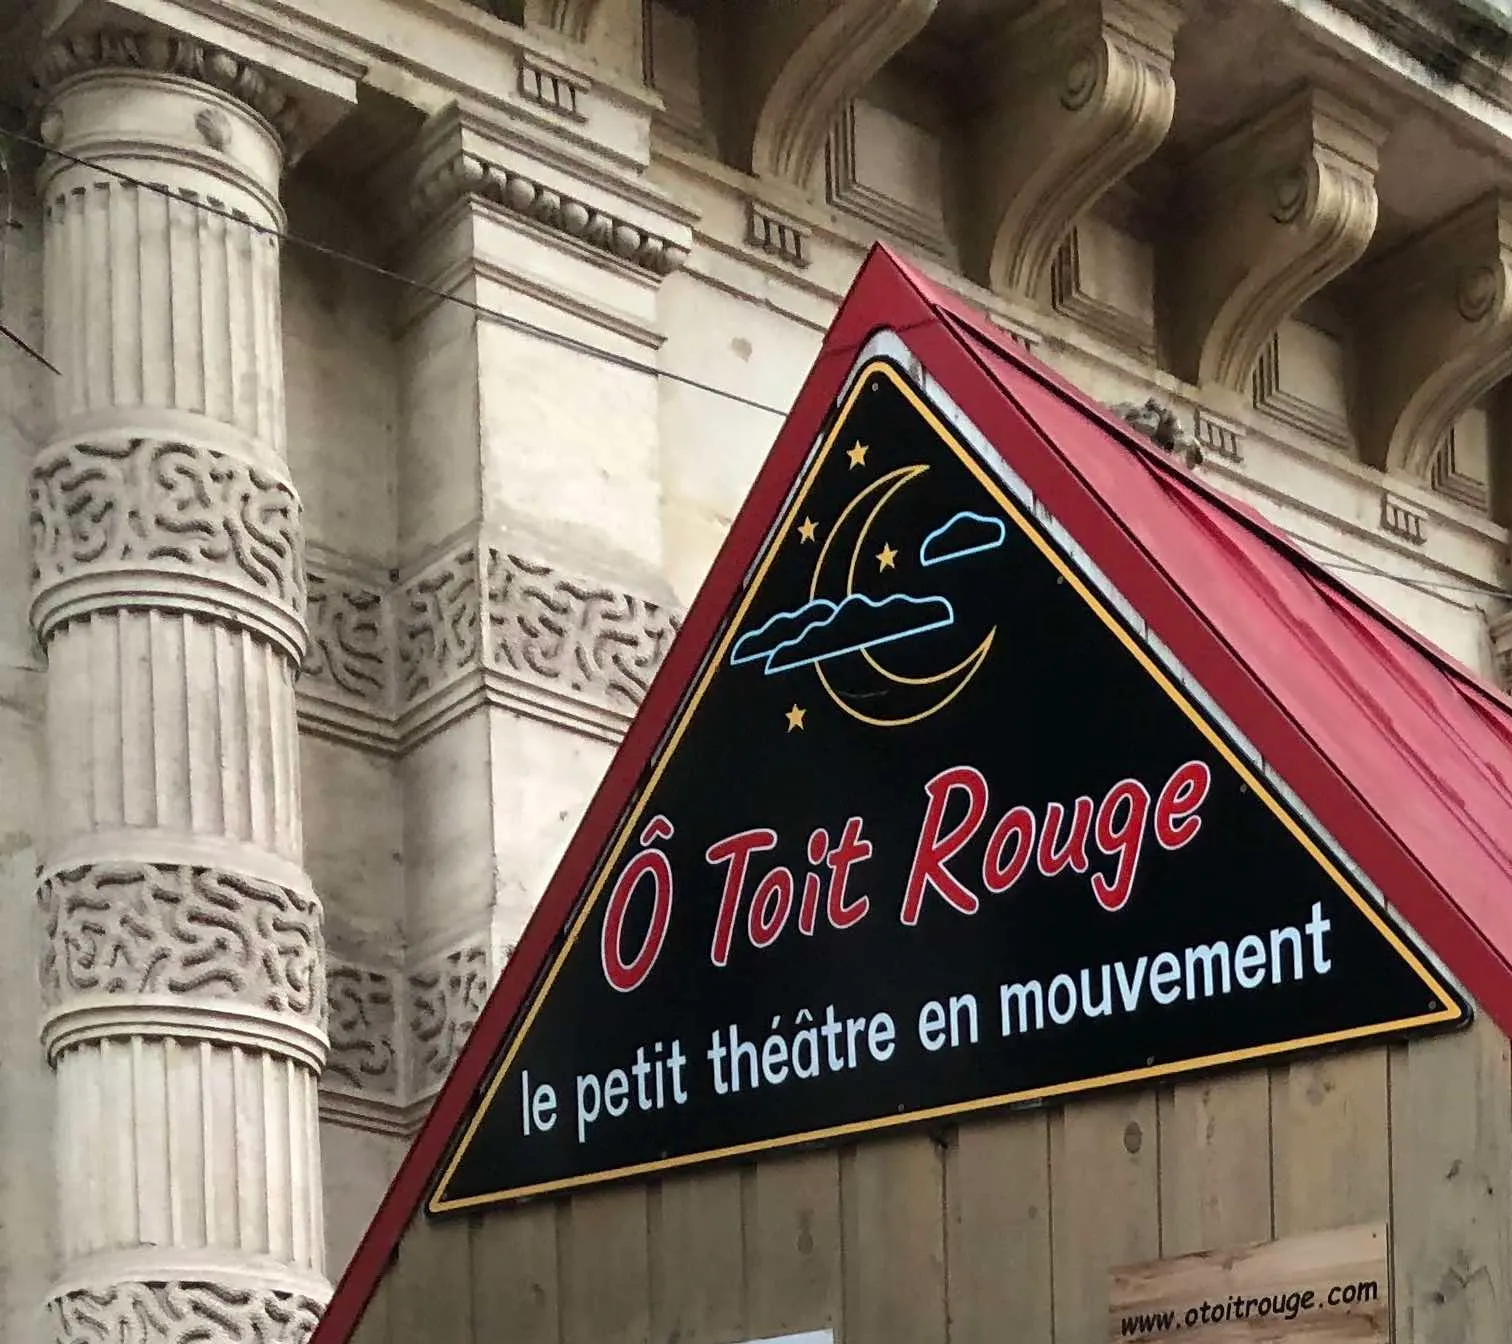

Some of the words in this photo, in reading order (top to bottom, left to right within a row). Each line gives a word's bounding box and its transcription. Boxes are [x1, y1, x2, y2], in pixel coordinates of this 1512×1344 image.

[600, 814, 675, 993] Ô
[705, 816, 873, 968] Toit
[899, 760, 1212, 926] Rouge
[521, 1068, 558, 1136] le
[576, 1039, 689, 1144] petit
[706, 1004, 897, 1096] théâtre
[917, 993, 979, 1052] en
[1000, 901, 1333, 1038] mouvement
[1120, 1280, 1379, 1336] www.otoitrouge.com
